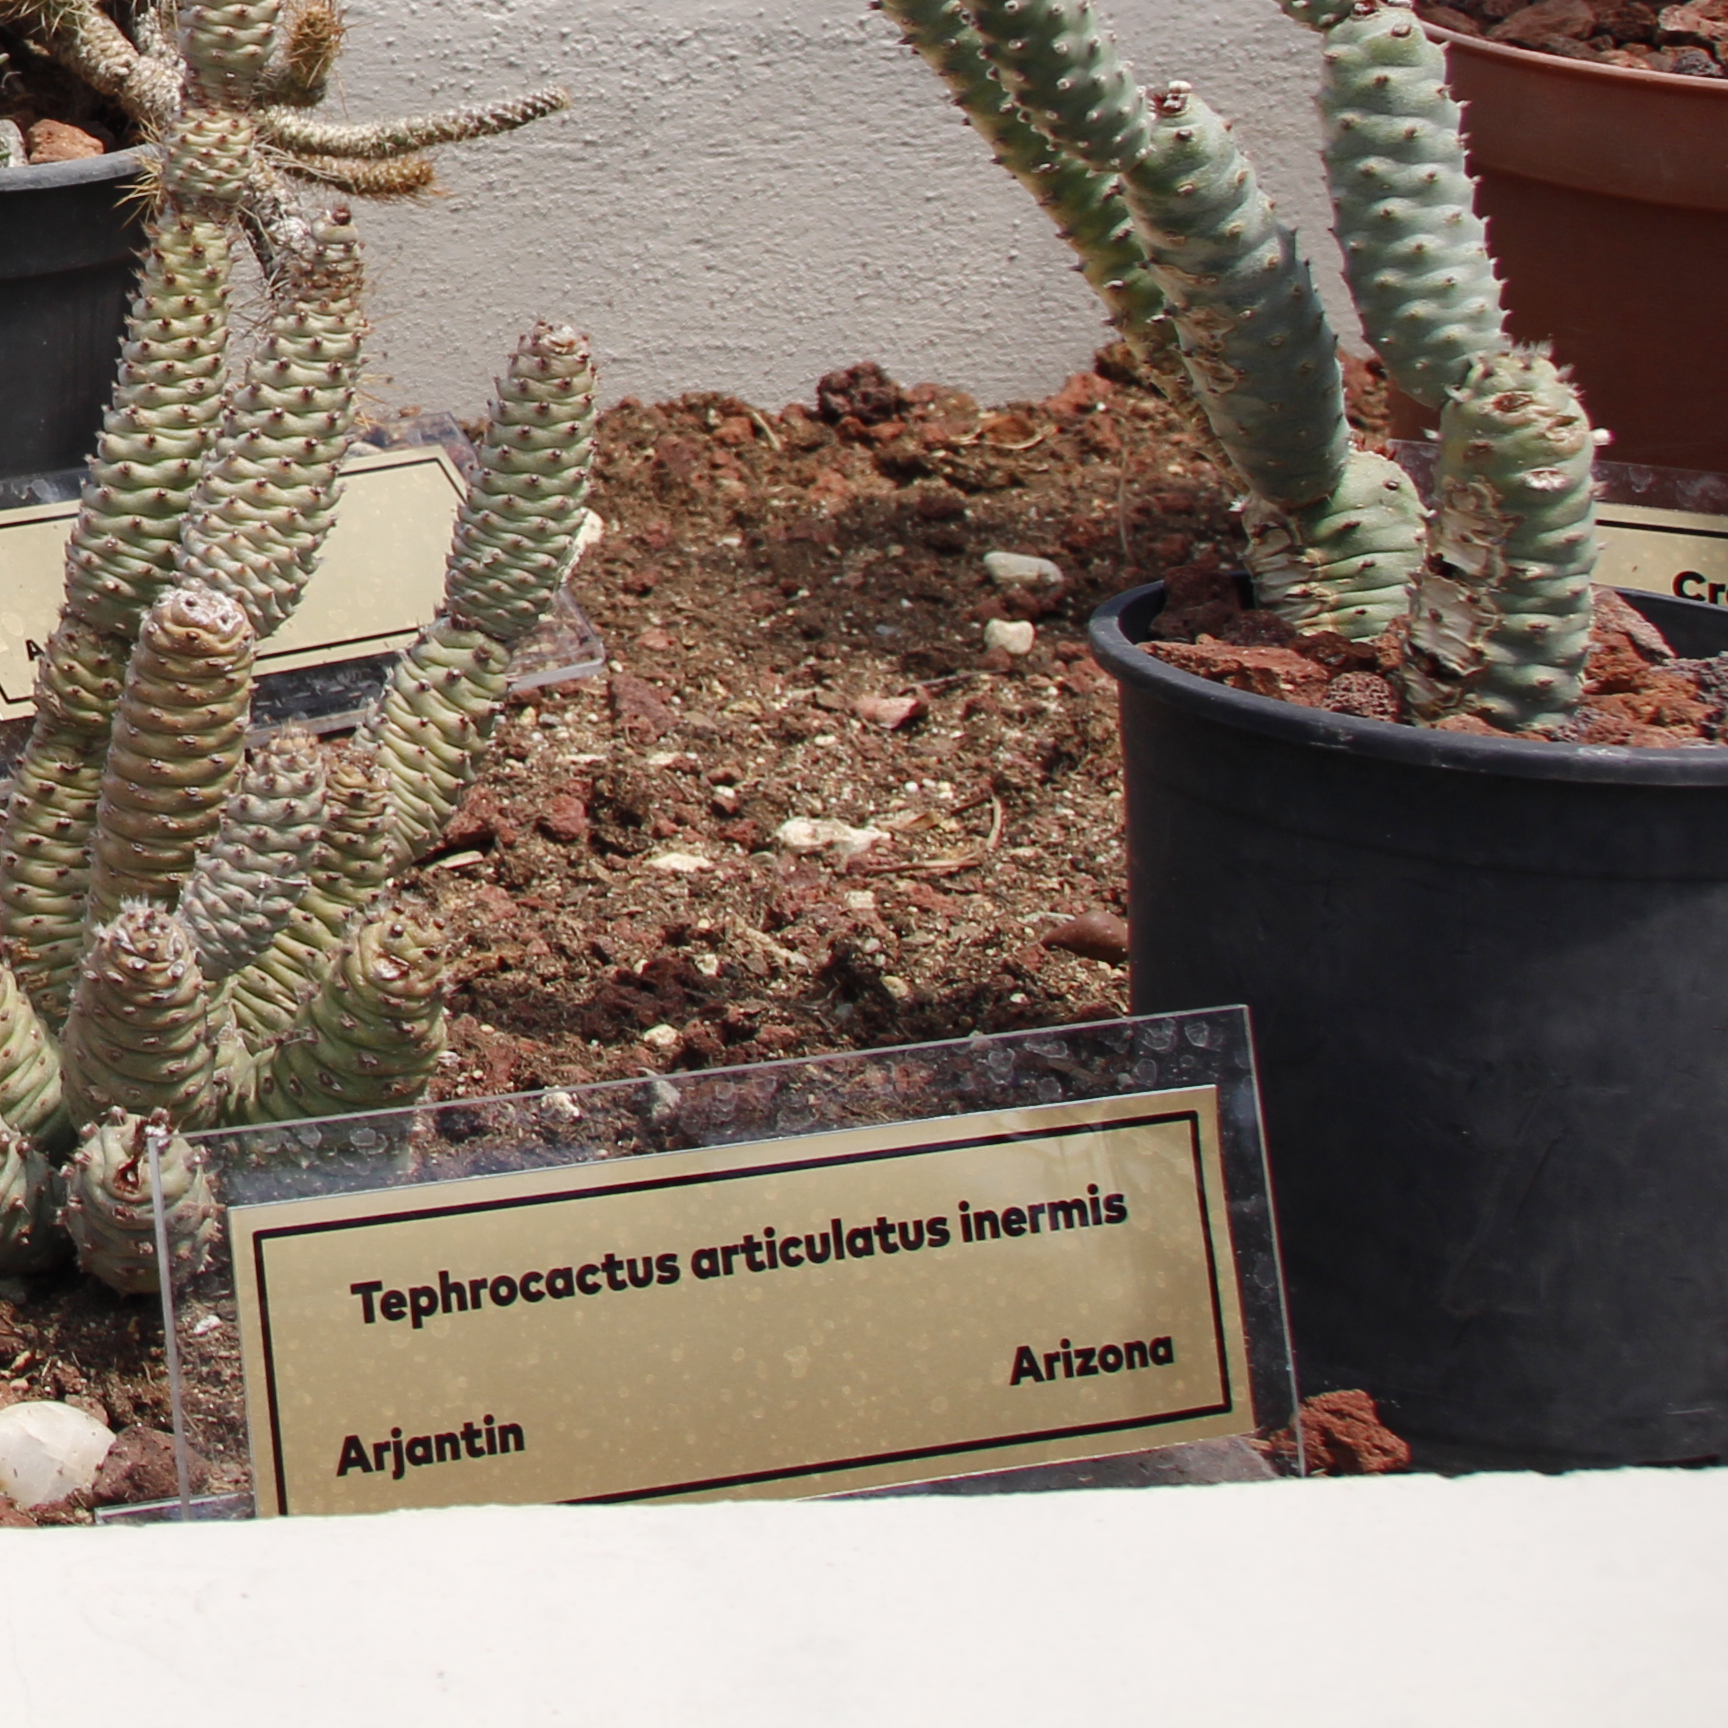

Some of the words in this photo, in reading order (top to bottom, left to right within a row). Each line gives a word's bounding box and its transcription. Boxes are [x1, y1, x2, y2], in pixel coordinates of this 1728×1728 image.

[1672, 570, 1728, 605] Cr
[350, 1253, 681, 1330] Tephrocactus
[691, 1216, 952, 1280] articulatus
[958, 1183, 1129, 1244] inermis
[1008, 1335, 1175, 1386] Arizona
[336, 1414, 526, 1481] Arjantin
